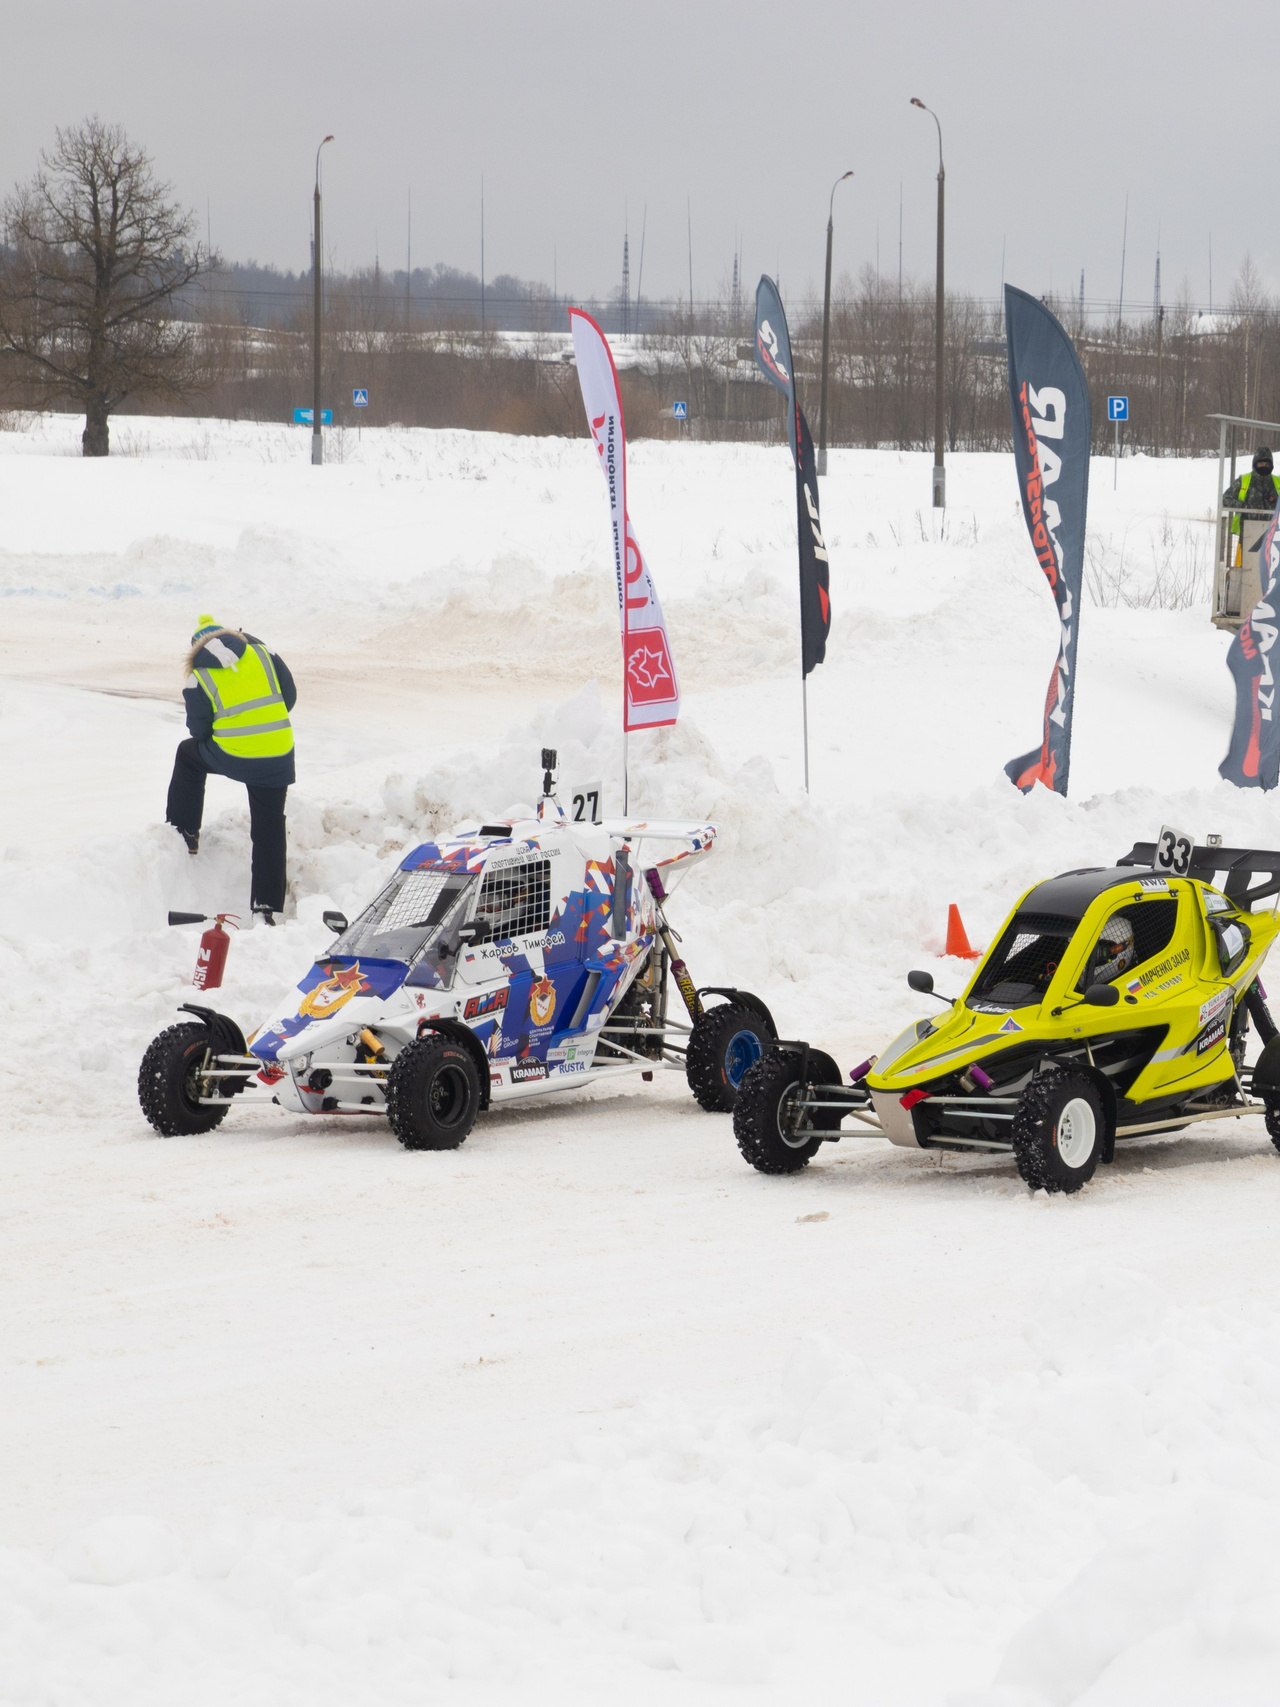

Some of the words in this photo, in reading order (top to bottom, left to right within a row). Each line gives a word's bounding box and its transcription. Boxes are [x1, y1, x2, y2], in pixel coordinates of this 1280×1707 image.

[1113, 399, 1125, 418] P
[607, 415, 617, 510] ТЕХНОЛОГИИ
[613, 520, 623, 611] ТОПЛИВНЫЕ
[572, 791, 599, 822] 27
[1158, 830, 1191, 874] 33
[198, 947, 212, 962] 2
[480, 943, 519, 960] Жарков
[522, 930, 566, 952] Тимофей
[1138, 959, 1173, 987] МАРЧЕНКО
[1170, 948, 1190, 968] ЗАХАР
[503, 1038, 520, 1048] GROUP
[1198, 1024, 1224, 1051] KRAMAR
[512, 1066, 546, 1079] KRAMAR
[558, 1062, 586, 1074] RUSTA
